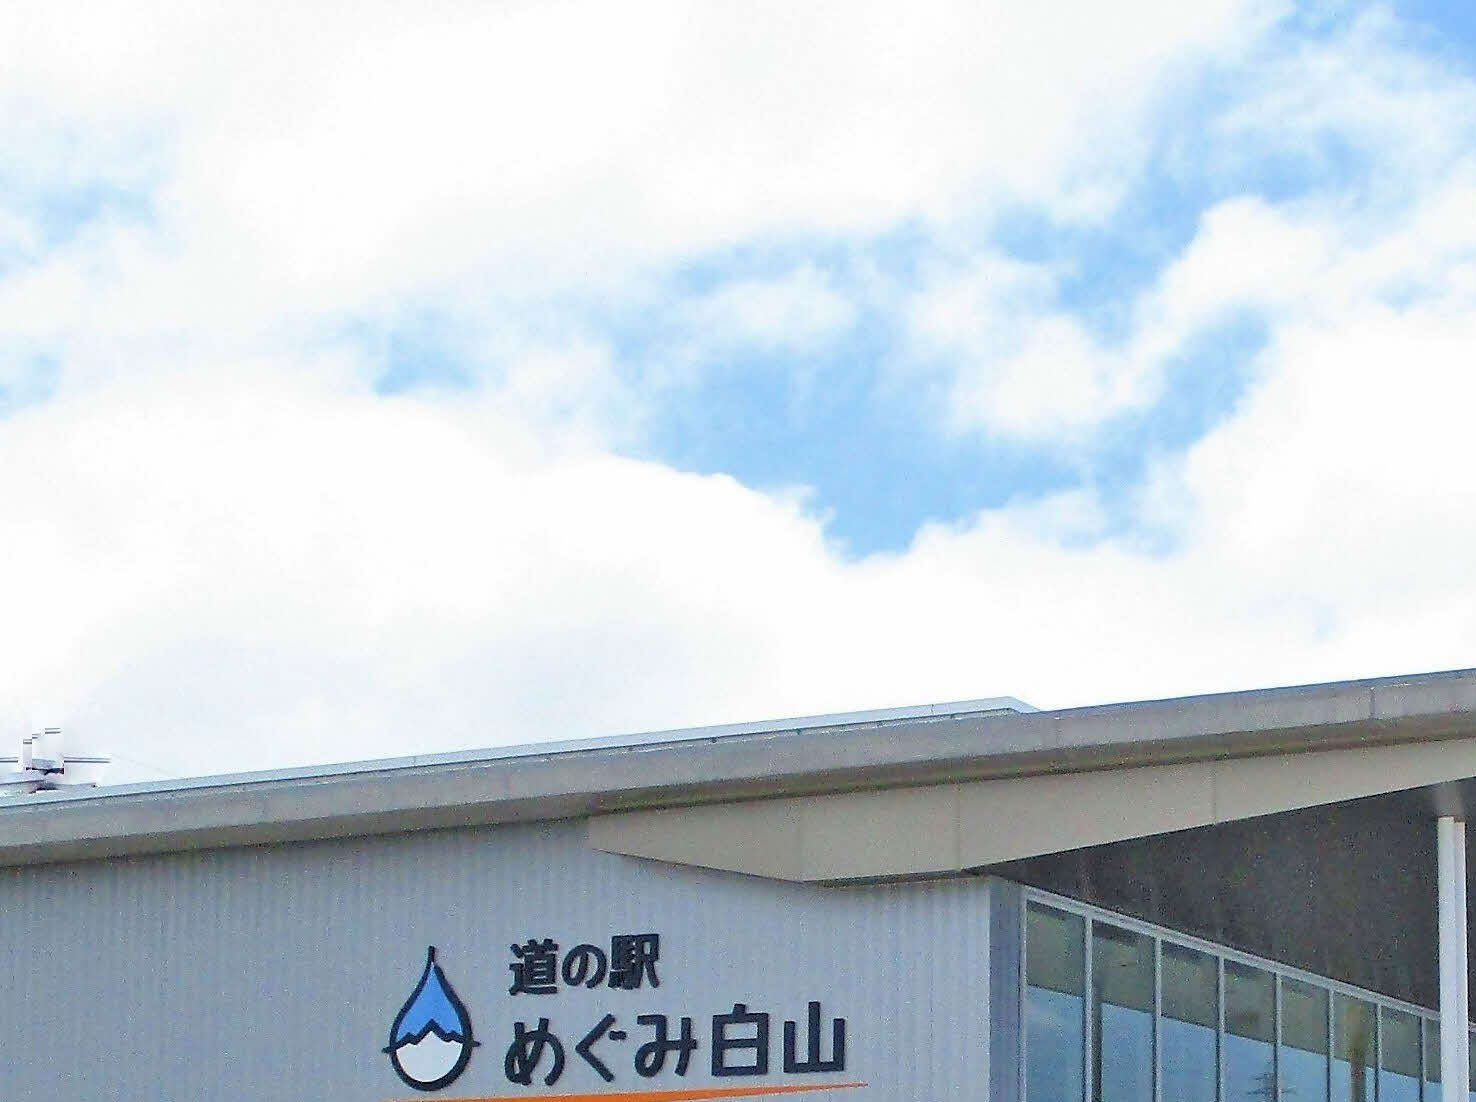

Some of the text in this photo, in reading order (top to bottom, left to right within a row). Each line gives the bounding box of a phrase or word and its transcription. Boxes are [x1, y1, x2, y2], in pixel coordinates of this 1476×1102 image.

[509, 934, 660, 995] 道の駅
[504, 1001, 846, 1086] めぐみ白山
